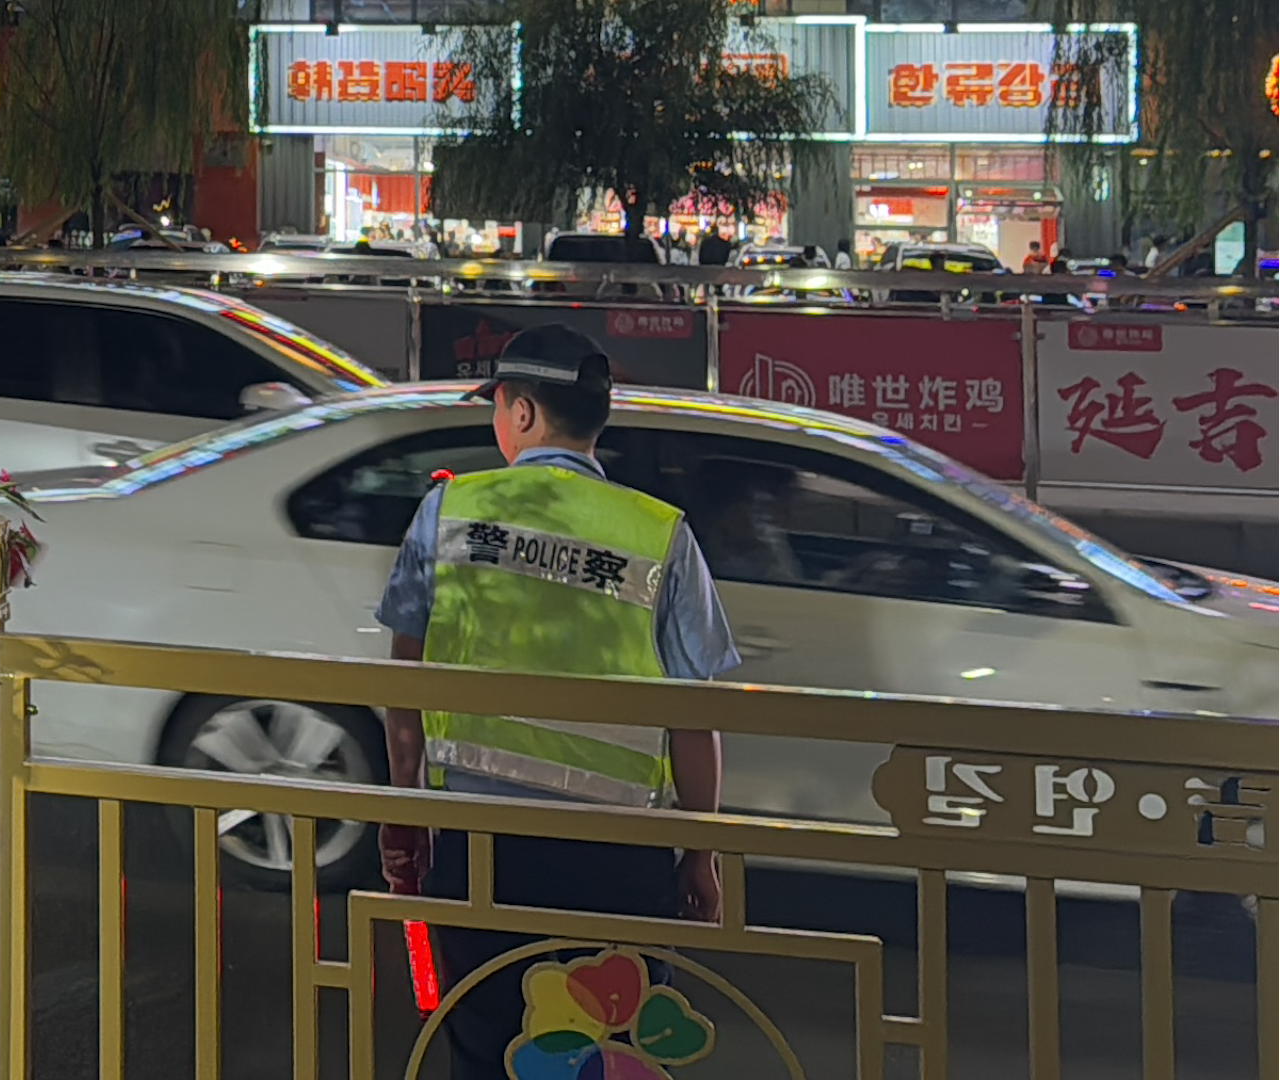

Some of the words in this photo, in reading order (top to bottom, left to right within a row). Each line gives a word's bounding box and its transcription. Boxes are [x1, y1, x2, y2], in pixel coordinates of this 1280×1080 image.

[828, 373, 1006, 414] 唯世炸鸡
[1056, 366, 1279, 471] 延吉
[466, 522, 511, 565] 警
[512, 535, 582, 576] POLICE
[581, 547, 630, 590] 察
